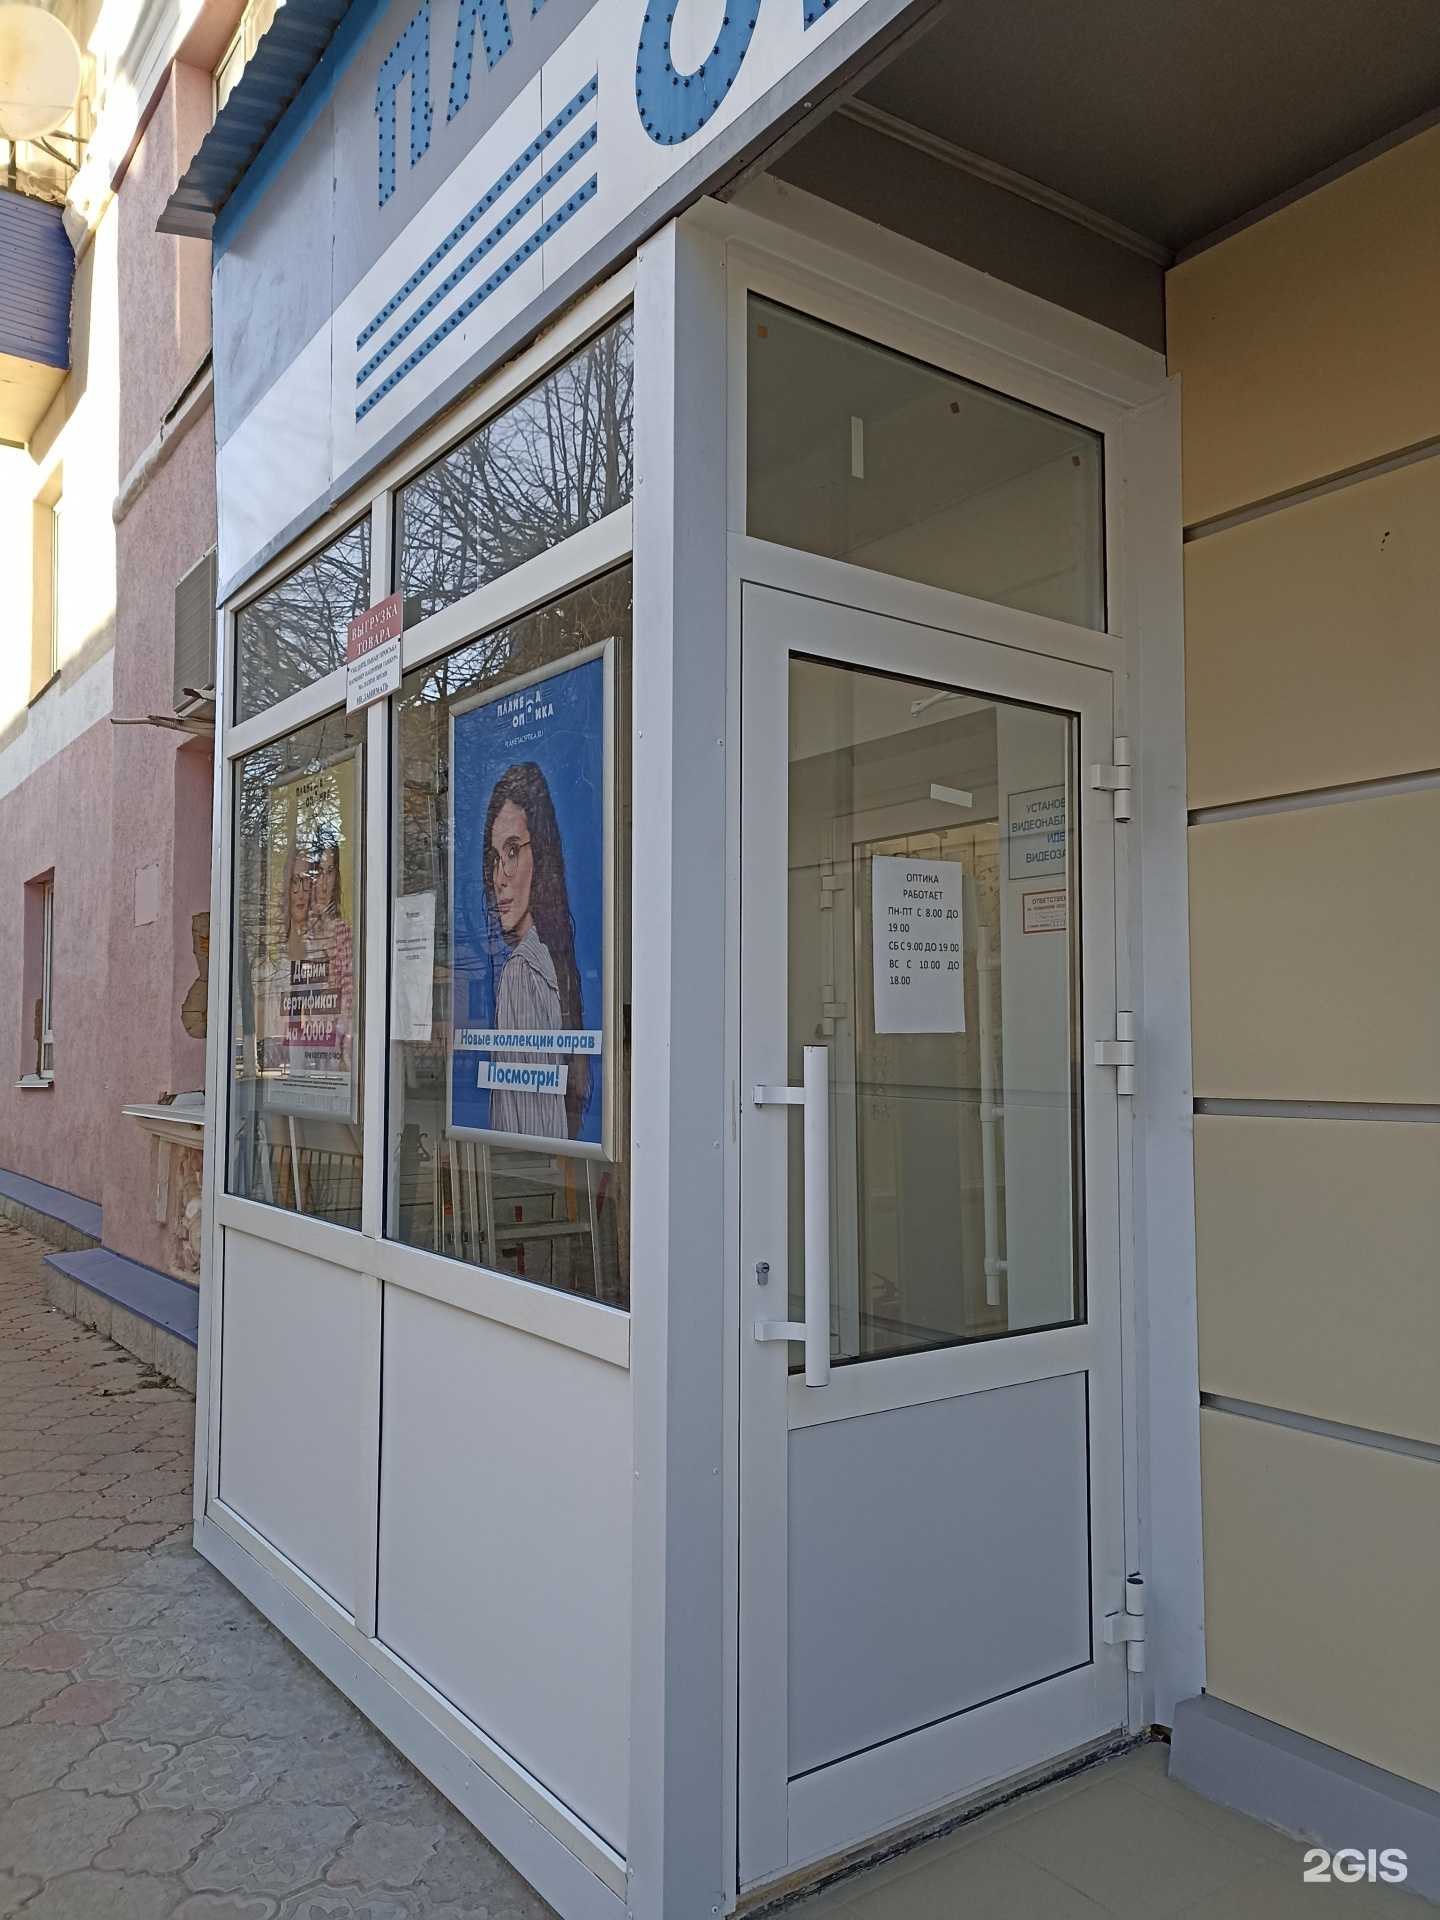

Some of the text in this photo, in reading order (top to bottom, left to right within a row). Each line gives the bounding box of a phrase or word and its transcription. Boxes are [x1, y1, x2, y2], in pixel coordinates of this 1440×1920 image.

[351, 603, 398, 641] ВЫГРУЗКА
[357, 627, 391, 655] ТОВАРА
[906, 873, 939, 884] ОПТИКА
[903, 889, 944, 900] РАБОТАЕТ
[888, 906, 959, 920] ПН-ПТ С 8.00 ДО
[888, 941, 899, 951] СБ
[900, 941, 906, 951] С
[906, 942, 924, 952] 9.00
[924, 943, 937, 952] ДО
[294, 960, 326, 984] Дарим
[889, 959, 960, 970] ВС С 10.00 ДО
[889, 975, 911, 985] 18.00
[283, 990, 338, 1016] сертификат
[461, 1030, 595, 1054] Новые коллекции оправ
[487, 1062, 560, 1092] Посмотри!
